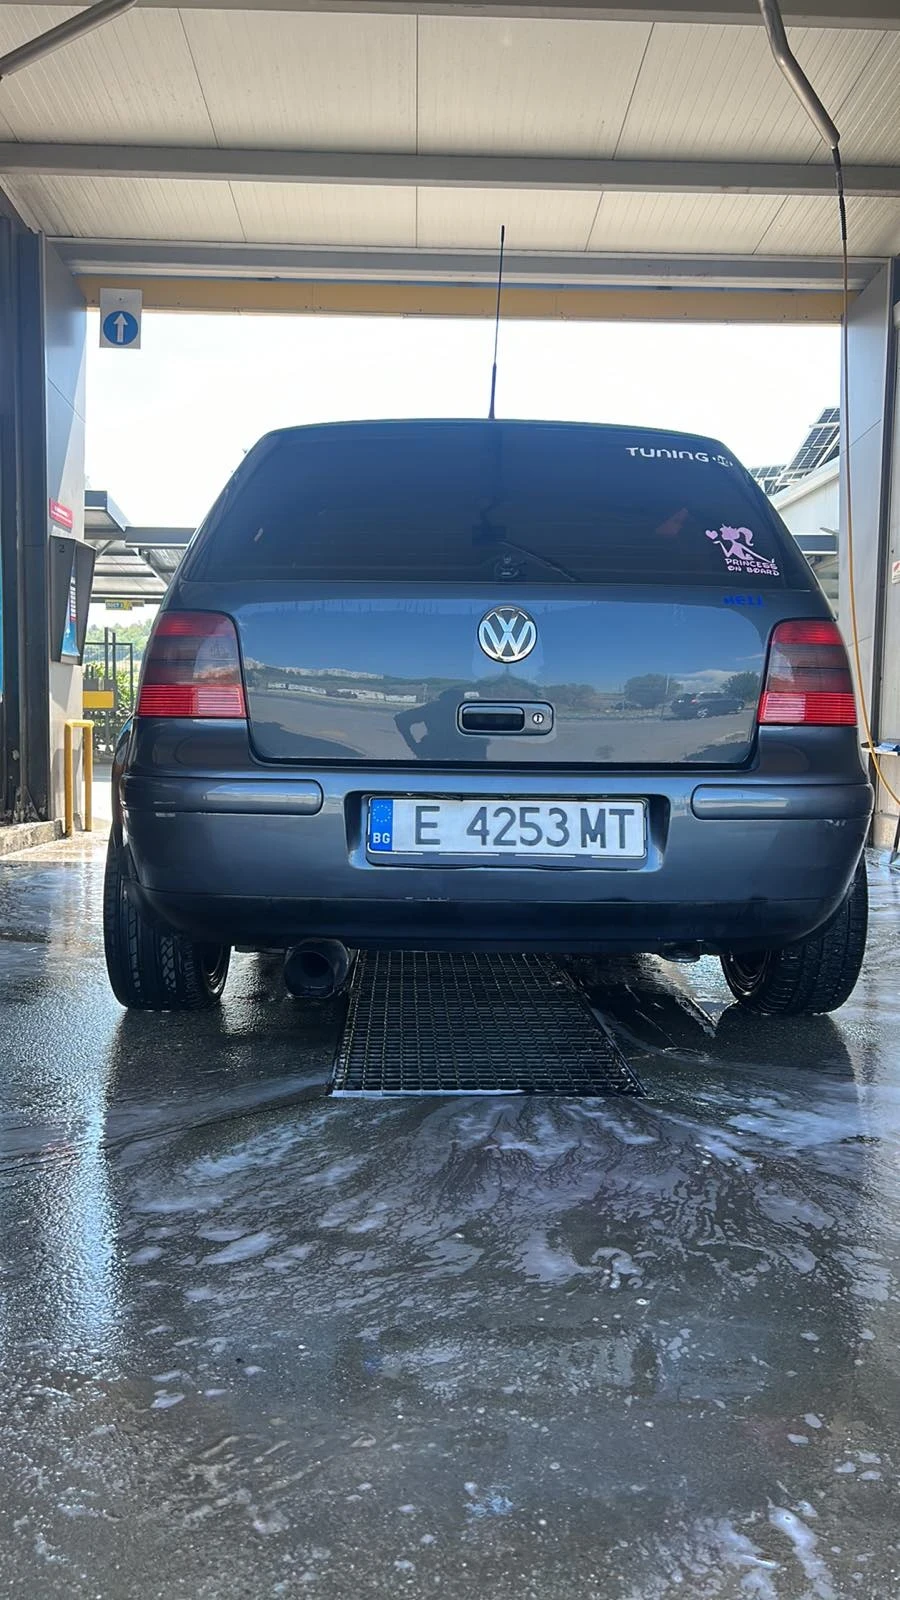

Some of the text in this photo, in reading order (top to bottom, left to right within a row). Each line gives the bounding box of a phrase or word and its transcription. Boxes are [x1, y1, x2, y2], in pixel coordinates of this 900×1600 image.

[625, 447, 709, 463] TUNING
[724, 558, 778, 570] PRINCESS
[746, 567, 780, 576] BOARD
[372, 805, 635, 849] BG E 4253 MT
